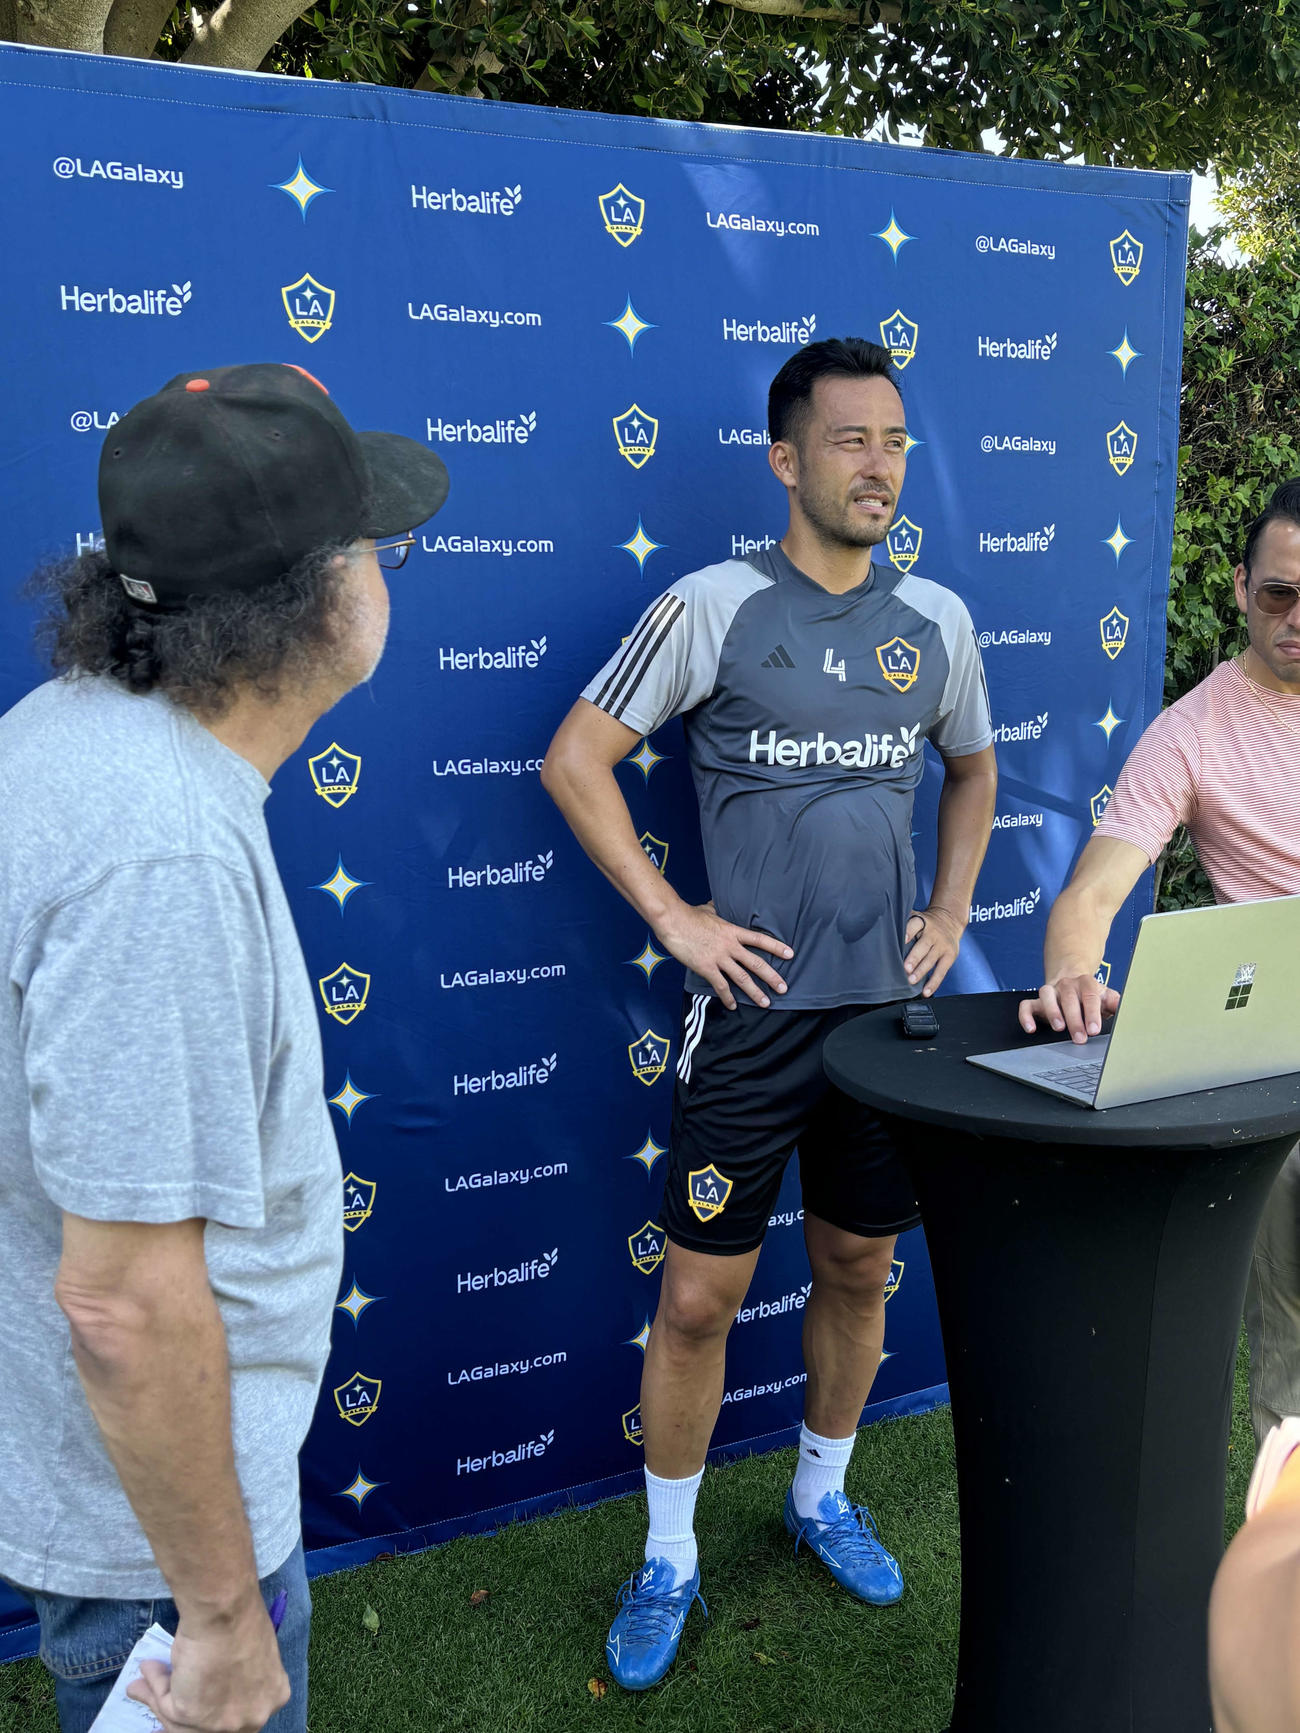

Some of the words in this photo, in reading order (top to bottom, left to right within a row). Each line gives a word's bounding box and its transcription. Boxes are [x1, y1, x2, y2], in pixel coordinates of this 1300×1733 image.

[53, 156, 184, 189] @LAGalaxy
[411, 184, 514, 216] Herbalife
[610, 205, 636, 224] LA
[706, 211, 820, 237] LAGalaxy.com
[975, 235, 1056, 260] @LAGalaxy
[1117, 248, 1137, 265] LA
[60, 284, 183, 316] Herbalife
[295, 298, 325, 317] LA
[294, 319, 327, 327] GALAXY
[407, 302, 542, 328] LAGalaxy.com
[722, 318, 810, 345] Herbalife
[889, 330, 911, 348] LA
[978, 335, 1051, 361] Herbalife
[70, 410, 129, 433] @LA
[426, 417, 529, 444] Herbalife
[624, 427, 650, 444] LA
[980, 435, 1056, 455] @LAGalaxy
[1112, 440, 1131, 455] LA
[422, 535, 554, 557] LAGalaxy.com
[893, 536, 914, 552] LA
[979, 531, 1049, 553] Herbalife
[978, 629, 1052, 648] @LAGalaxy
[1106, 625, 1123, 640] LA
[439, 645, 539, 670] Herbalife
[822, 648, 847, 682] 4
[887, 655, 913, 672] LA
[992, 720, 1042, 744] rbalife
[749, 729, 910, 769] Herbalife
[321, 766, 351, 783] LA
[448, 860, 546, 889] Herbalife
[968, 896, 1035, 924] Herbalife
[440, 964, 566, 989] LAGalaxy.com
[331, 984, 360, 1002] LA
[638, 1049, 661, 1066] LA
[453, 1063, 549, 1096] Herbalife
[445, 1162, 568, 1193] LAGalaxy.com
[695, 1182, 720, 1202] LA
[637, 1239, 660, 1256] LA
[457, 1259, 550, 1294] Herbalife
[447, 1351, 567, 1386] LAGalaxy.com
[345, 1390, 373, 1408] LA
[457, 1440, 546, 1476] Herbalife
